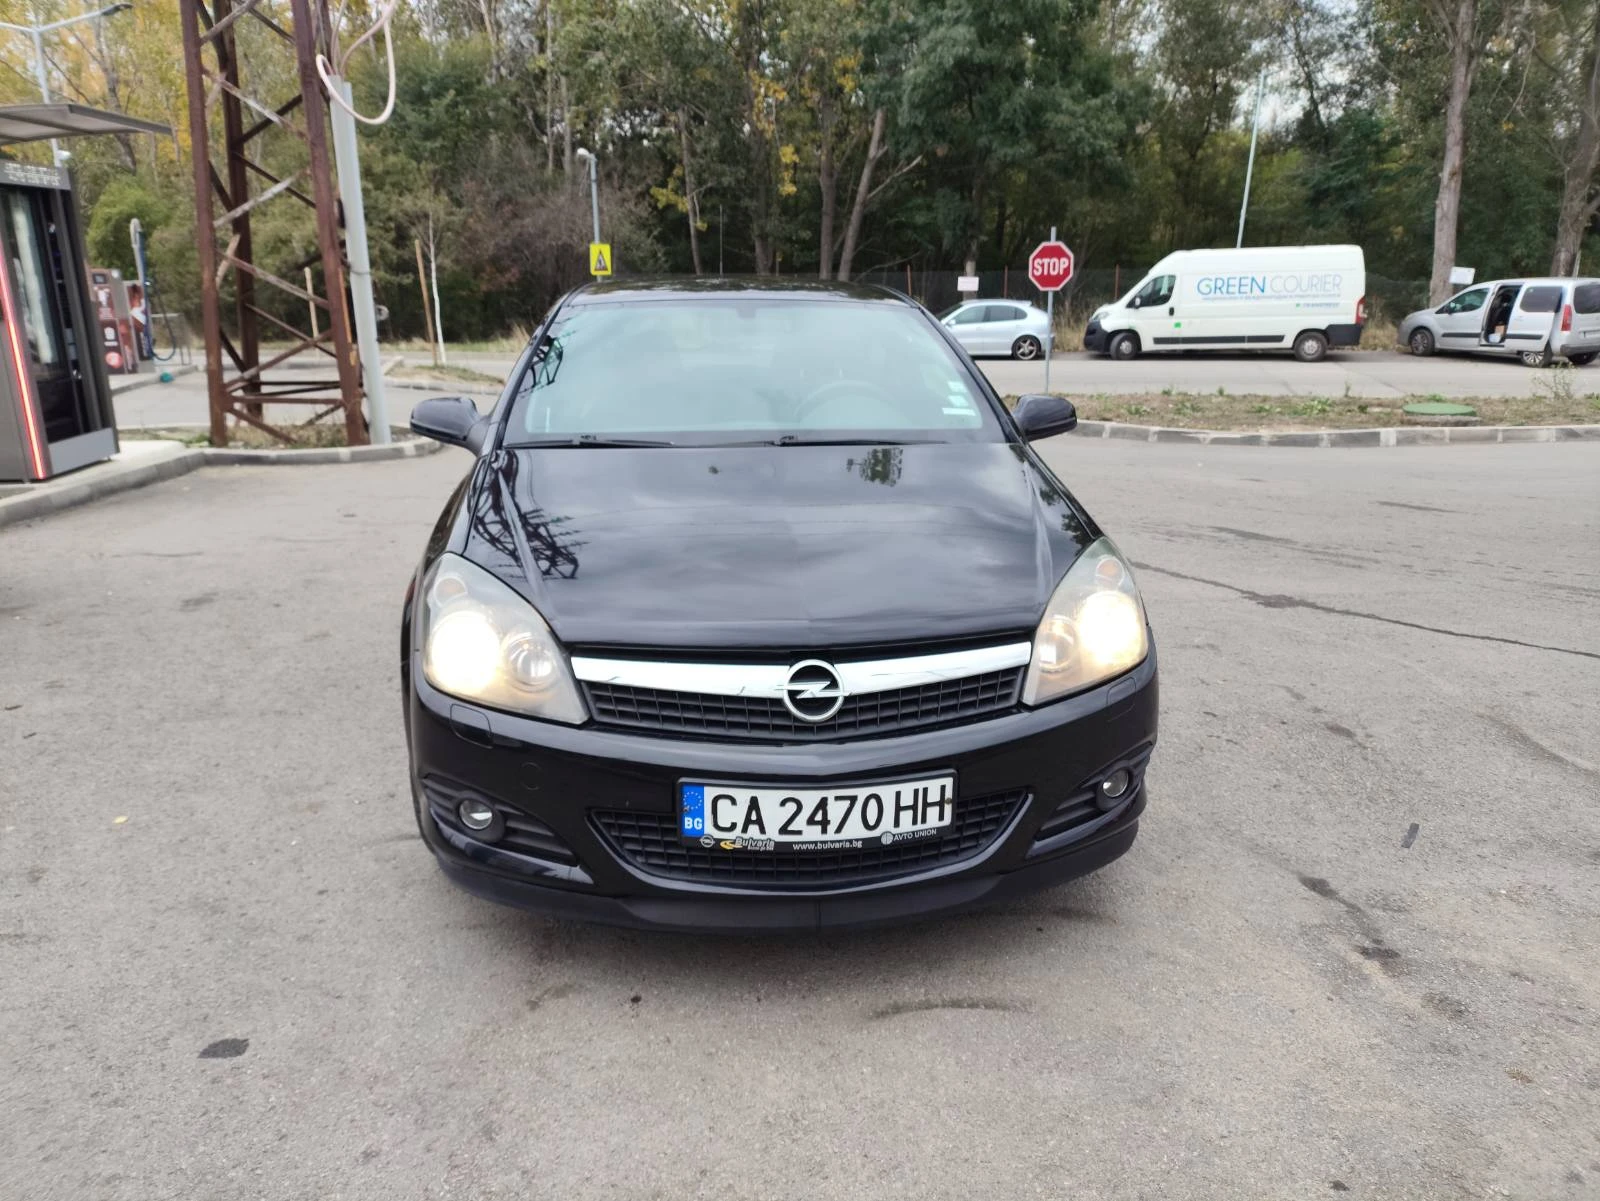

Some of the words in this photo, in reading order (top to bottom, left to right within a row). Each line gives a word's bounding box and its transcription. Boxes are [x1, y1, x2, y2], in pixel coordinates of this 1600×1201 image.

[1033, 256, 1069, 276] STOP
[1197, 276, 1266, 296] GREEN
[1269, 274, 1343, 294] COURIER
[711, 793, 767, 835] CA
[778, 793, 884, 835] 2470
[893, 784, 946, 828] HH
[684, 816, 703, 831] BG
[893, 832, 914, 842] AVTO
[914, 828, 937, 838] UNION
[792, 839, 863, 850] www.bulvaria.bg
